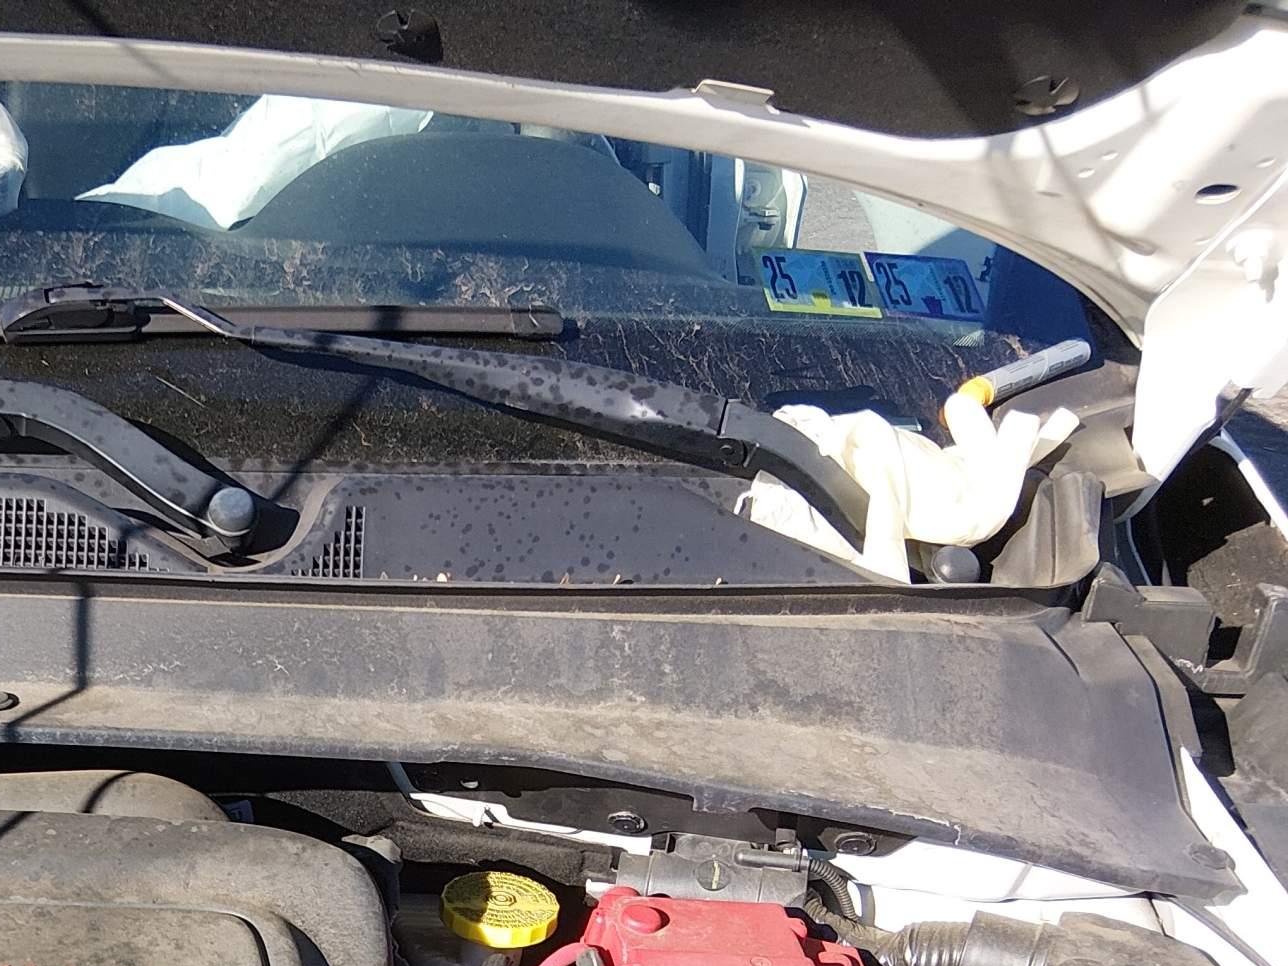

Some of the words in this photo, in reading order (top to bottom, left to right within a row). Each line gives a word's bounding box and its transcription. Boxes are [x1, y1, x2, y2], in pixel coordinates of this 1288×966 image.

[762, 255, 798, 300] 25
[838, 270, 873, 308] 12
[876, 262, 912, 306] 25
[943, 275, 980, 314] 12
